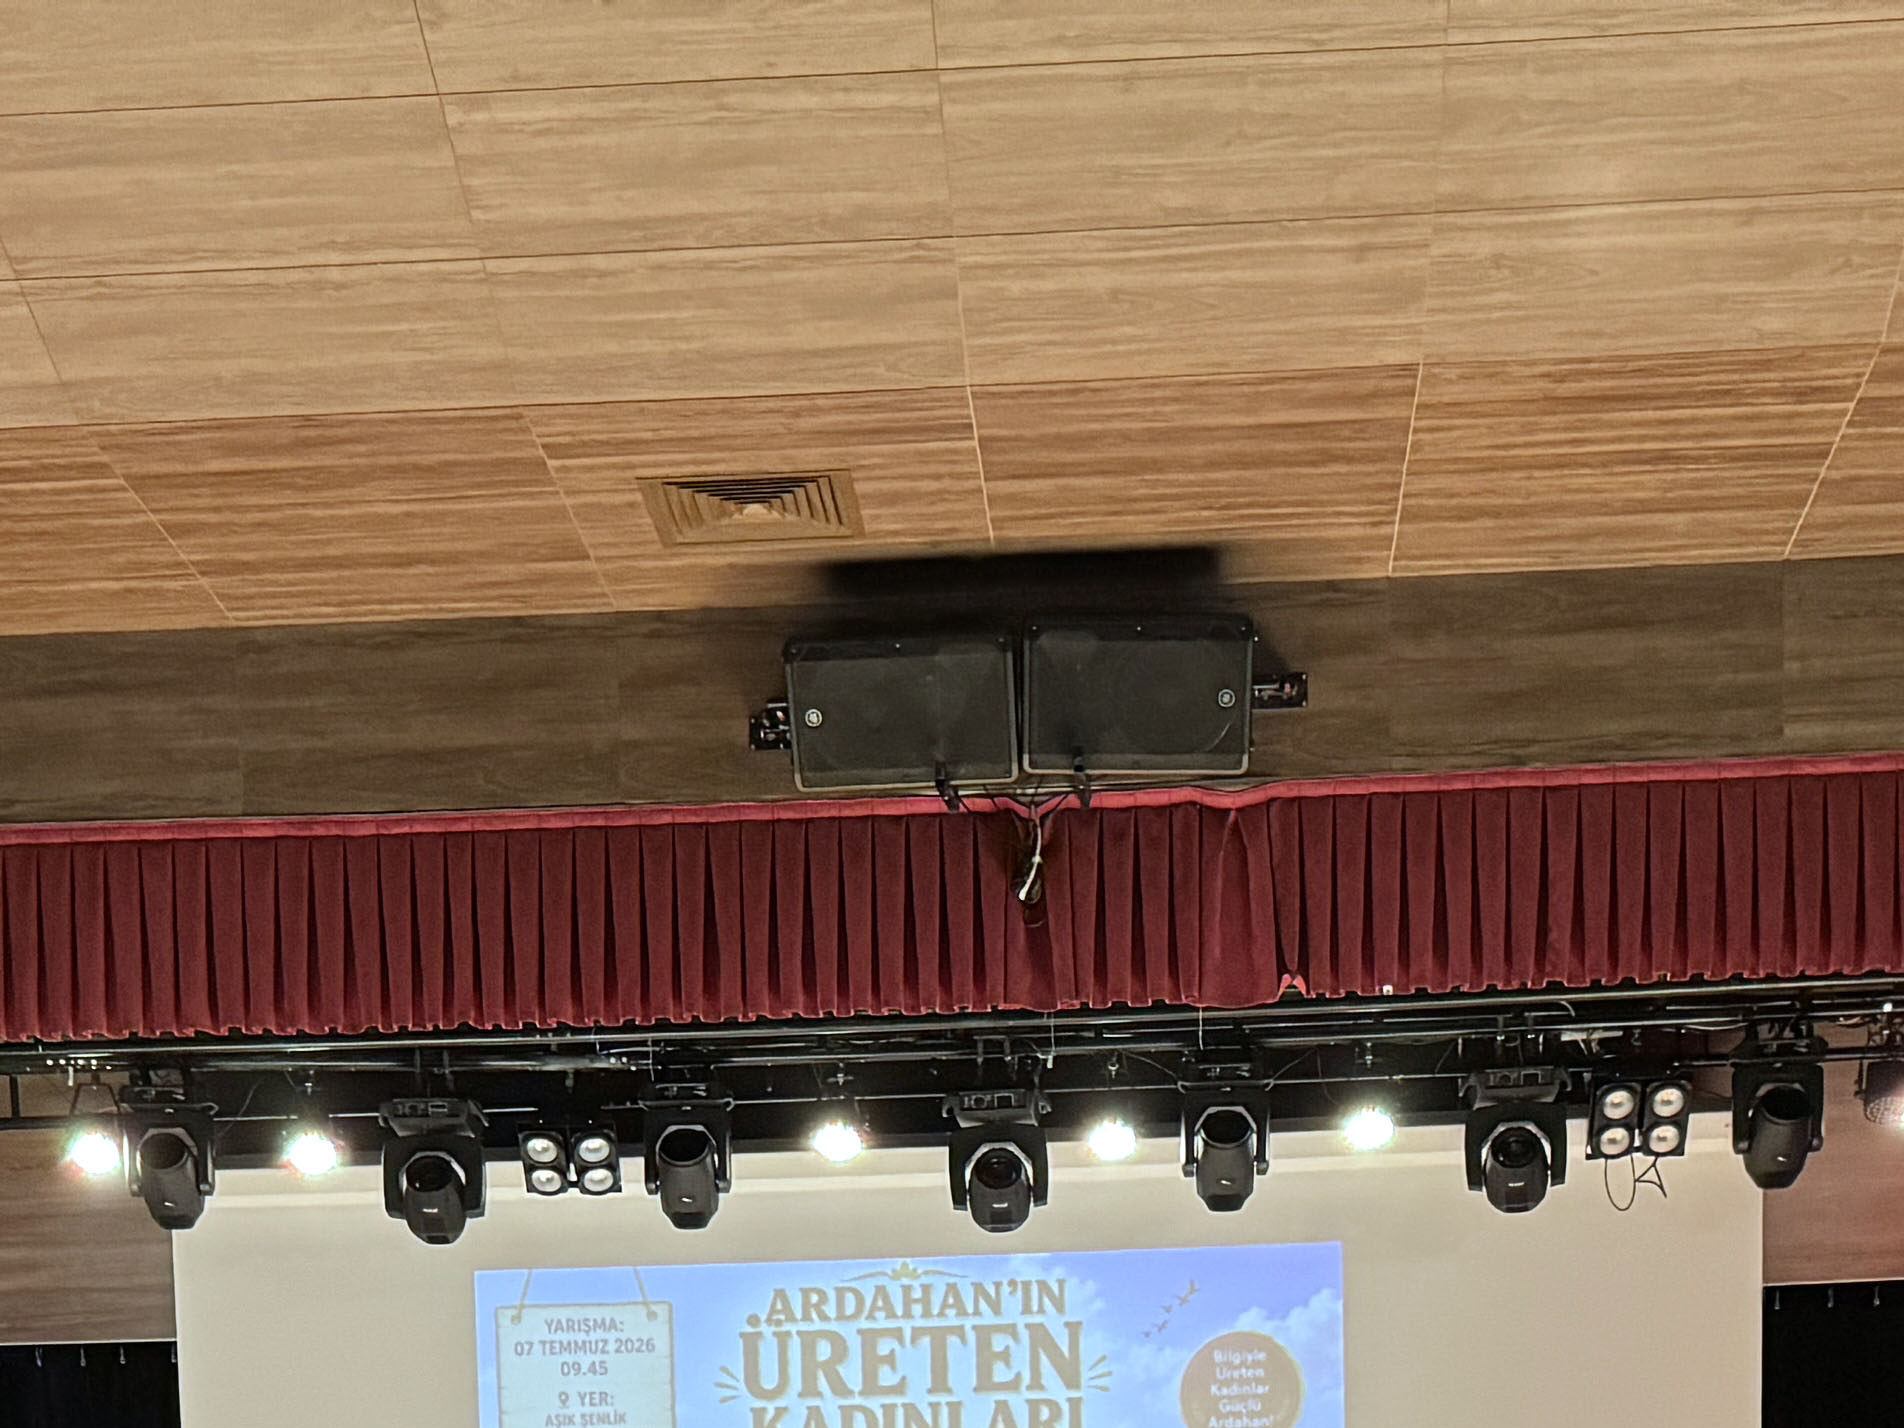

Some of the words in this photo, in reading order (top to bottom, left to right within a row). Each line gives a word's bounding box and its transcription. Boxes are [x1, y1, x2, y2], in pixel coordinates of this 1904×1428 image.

[545, 1318, 624, 1336] YARIŞMA:
[514, 1341, 534, 1356] 07
[538, 1339, 609, 1355] TEMMUZ
[614, 1338, 656, 1353] 2026
[739, 1313, 1083, 1401] ÜRETEN
[561, 1361, 608, 1376] 09.45
[578, 1392, 614, 1407] YER:
[545, 1413, 576, 1428] AŞIK
[580, 1410, 626, 1427] ŞENLİK
